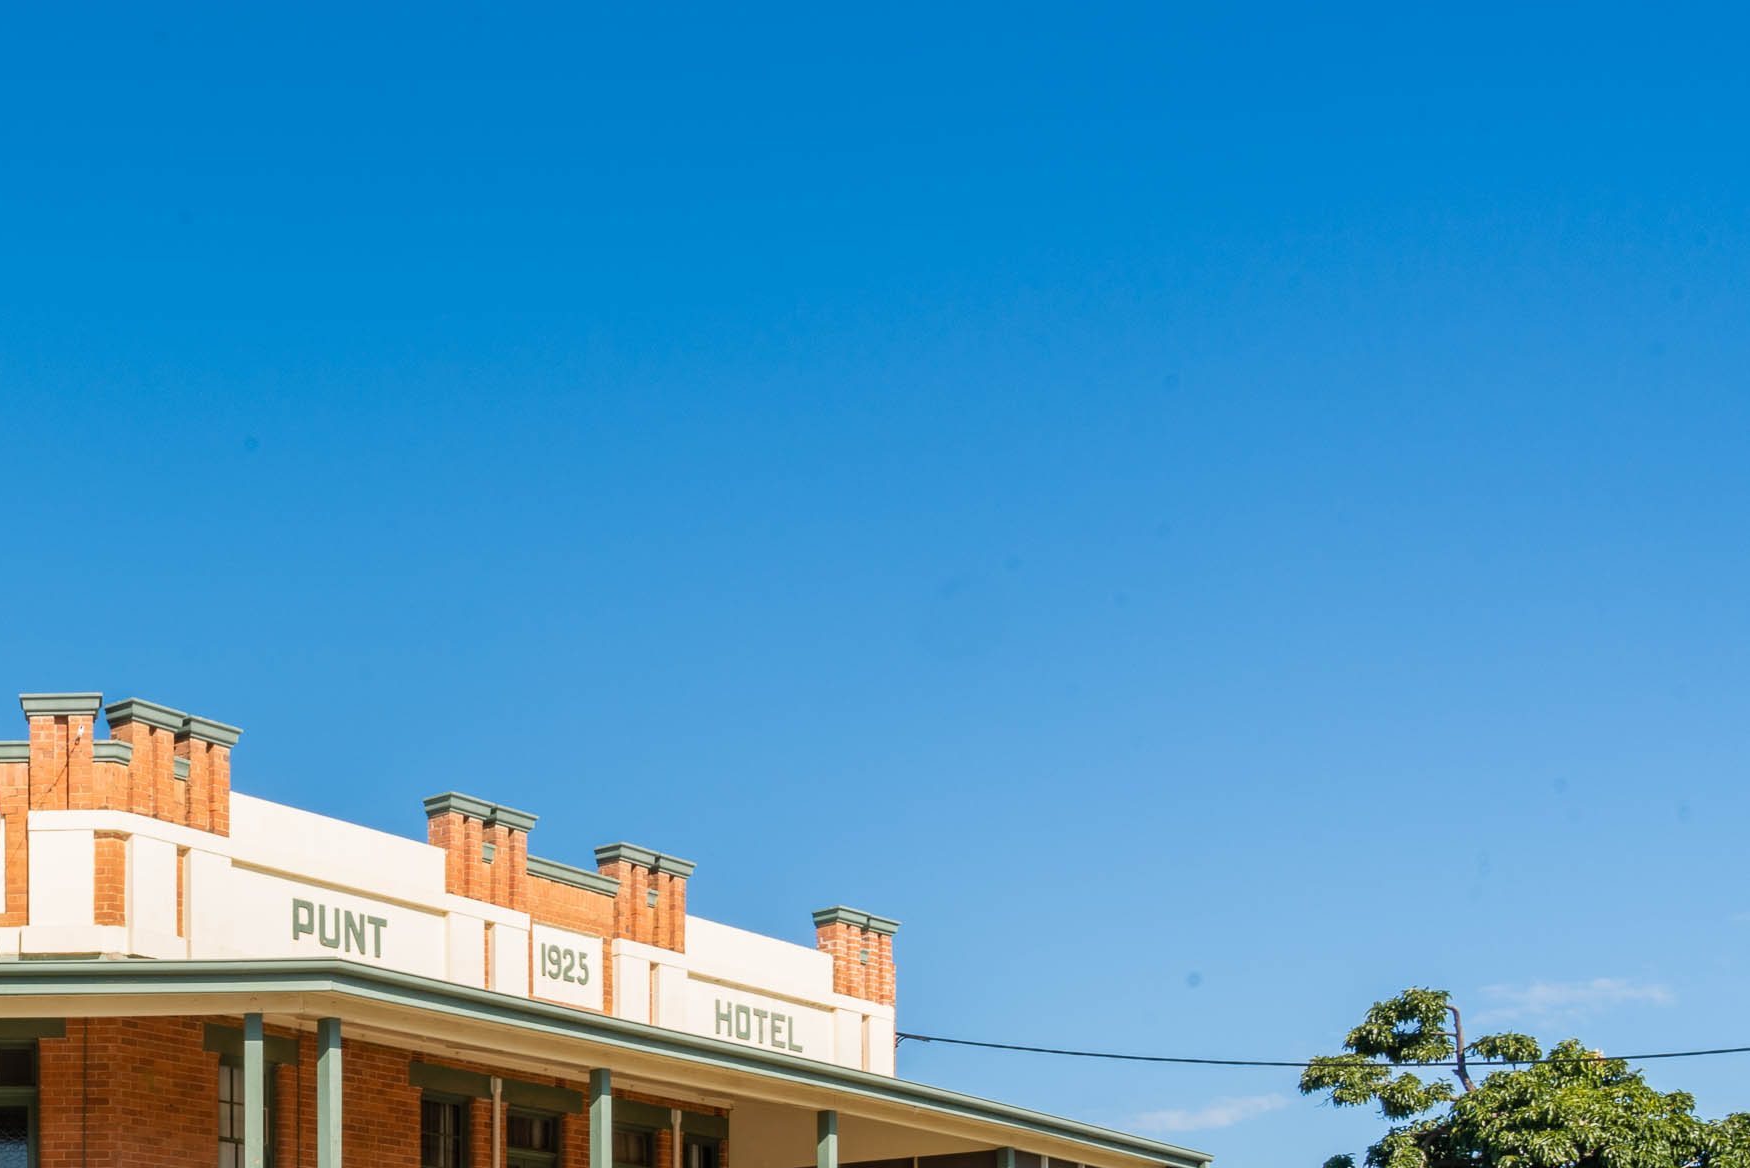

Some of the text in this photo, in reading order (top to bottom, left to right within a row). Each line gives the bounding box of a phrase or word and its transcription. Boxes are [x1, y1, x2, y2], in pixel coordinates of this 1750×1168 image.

[293, 898, 387, 958] PUNT
[541, 943, 589, 985] 1925
[715, 999, 802, 1053] HOTEL
